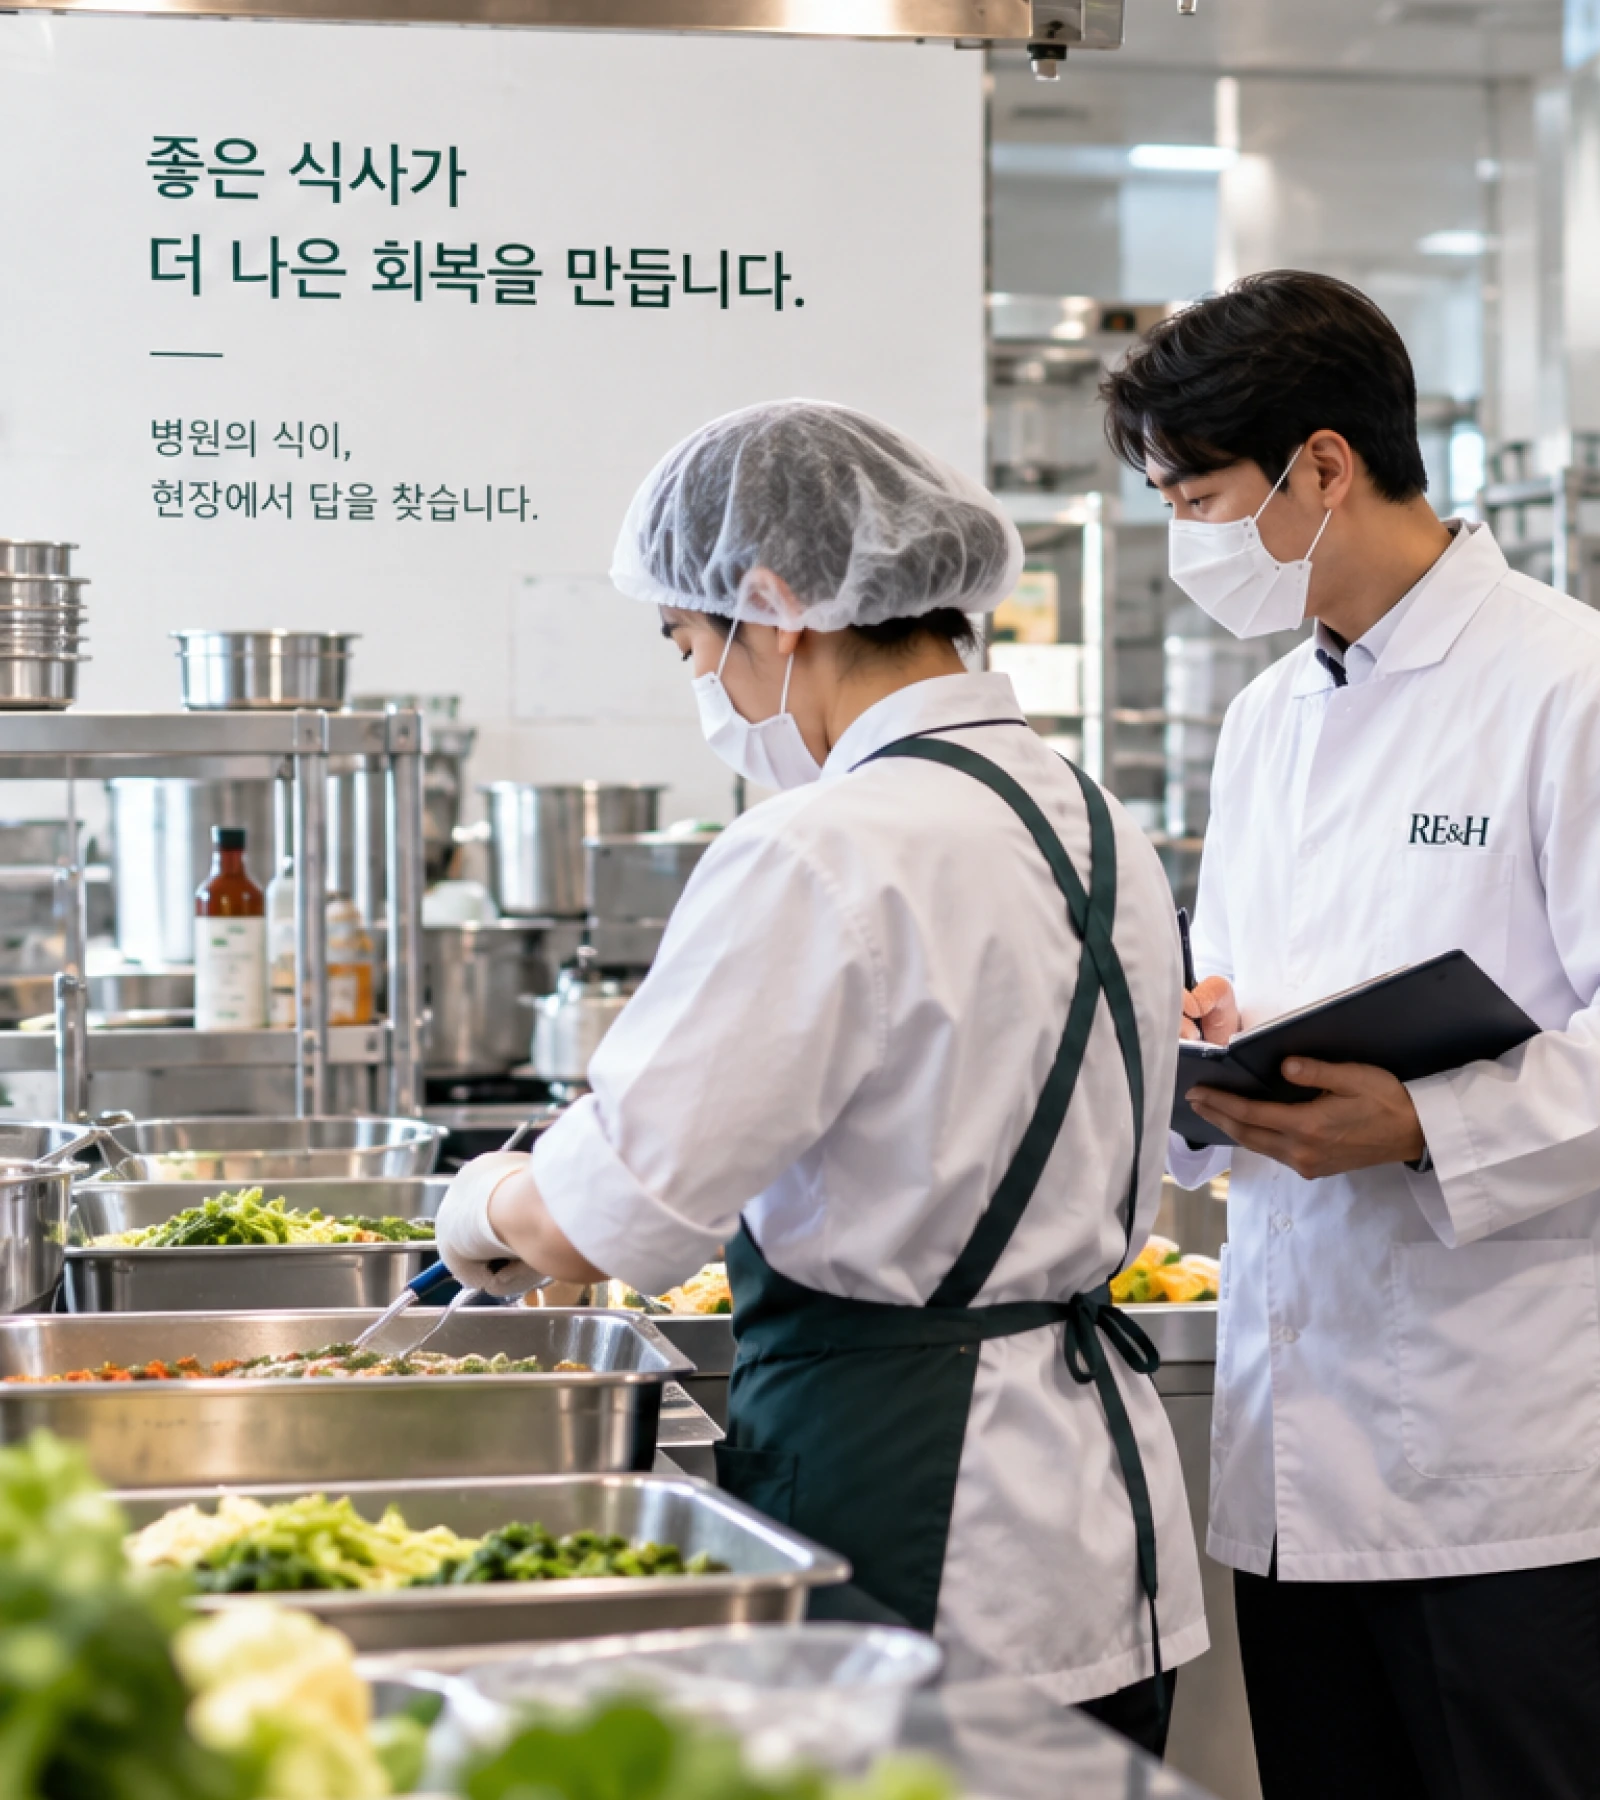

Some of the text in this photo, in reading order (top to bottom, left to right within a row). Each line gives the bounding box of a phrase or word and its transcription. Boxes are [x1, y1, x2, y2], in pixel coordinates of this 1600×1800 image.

[146, 135, 467, 208] 좋은 식사가
[150, 233, 805, 312] 더 나은 회복을 만듭니다.
[151, 418, 351, 462] 병원의 식이,
[151, 479, 538, 523] 현장에서 답을 찾습니다.
[1409, 813, 1490, 846] RE&H
